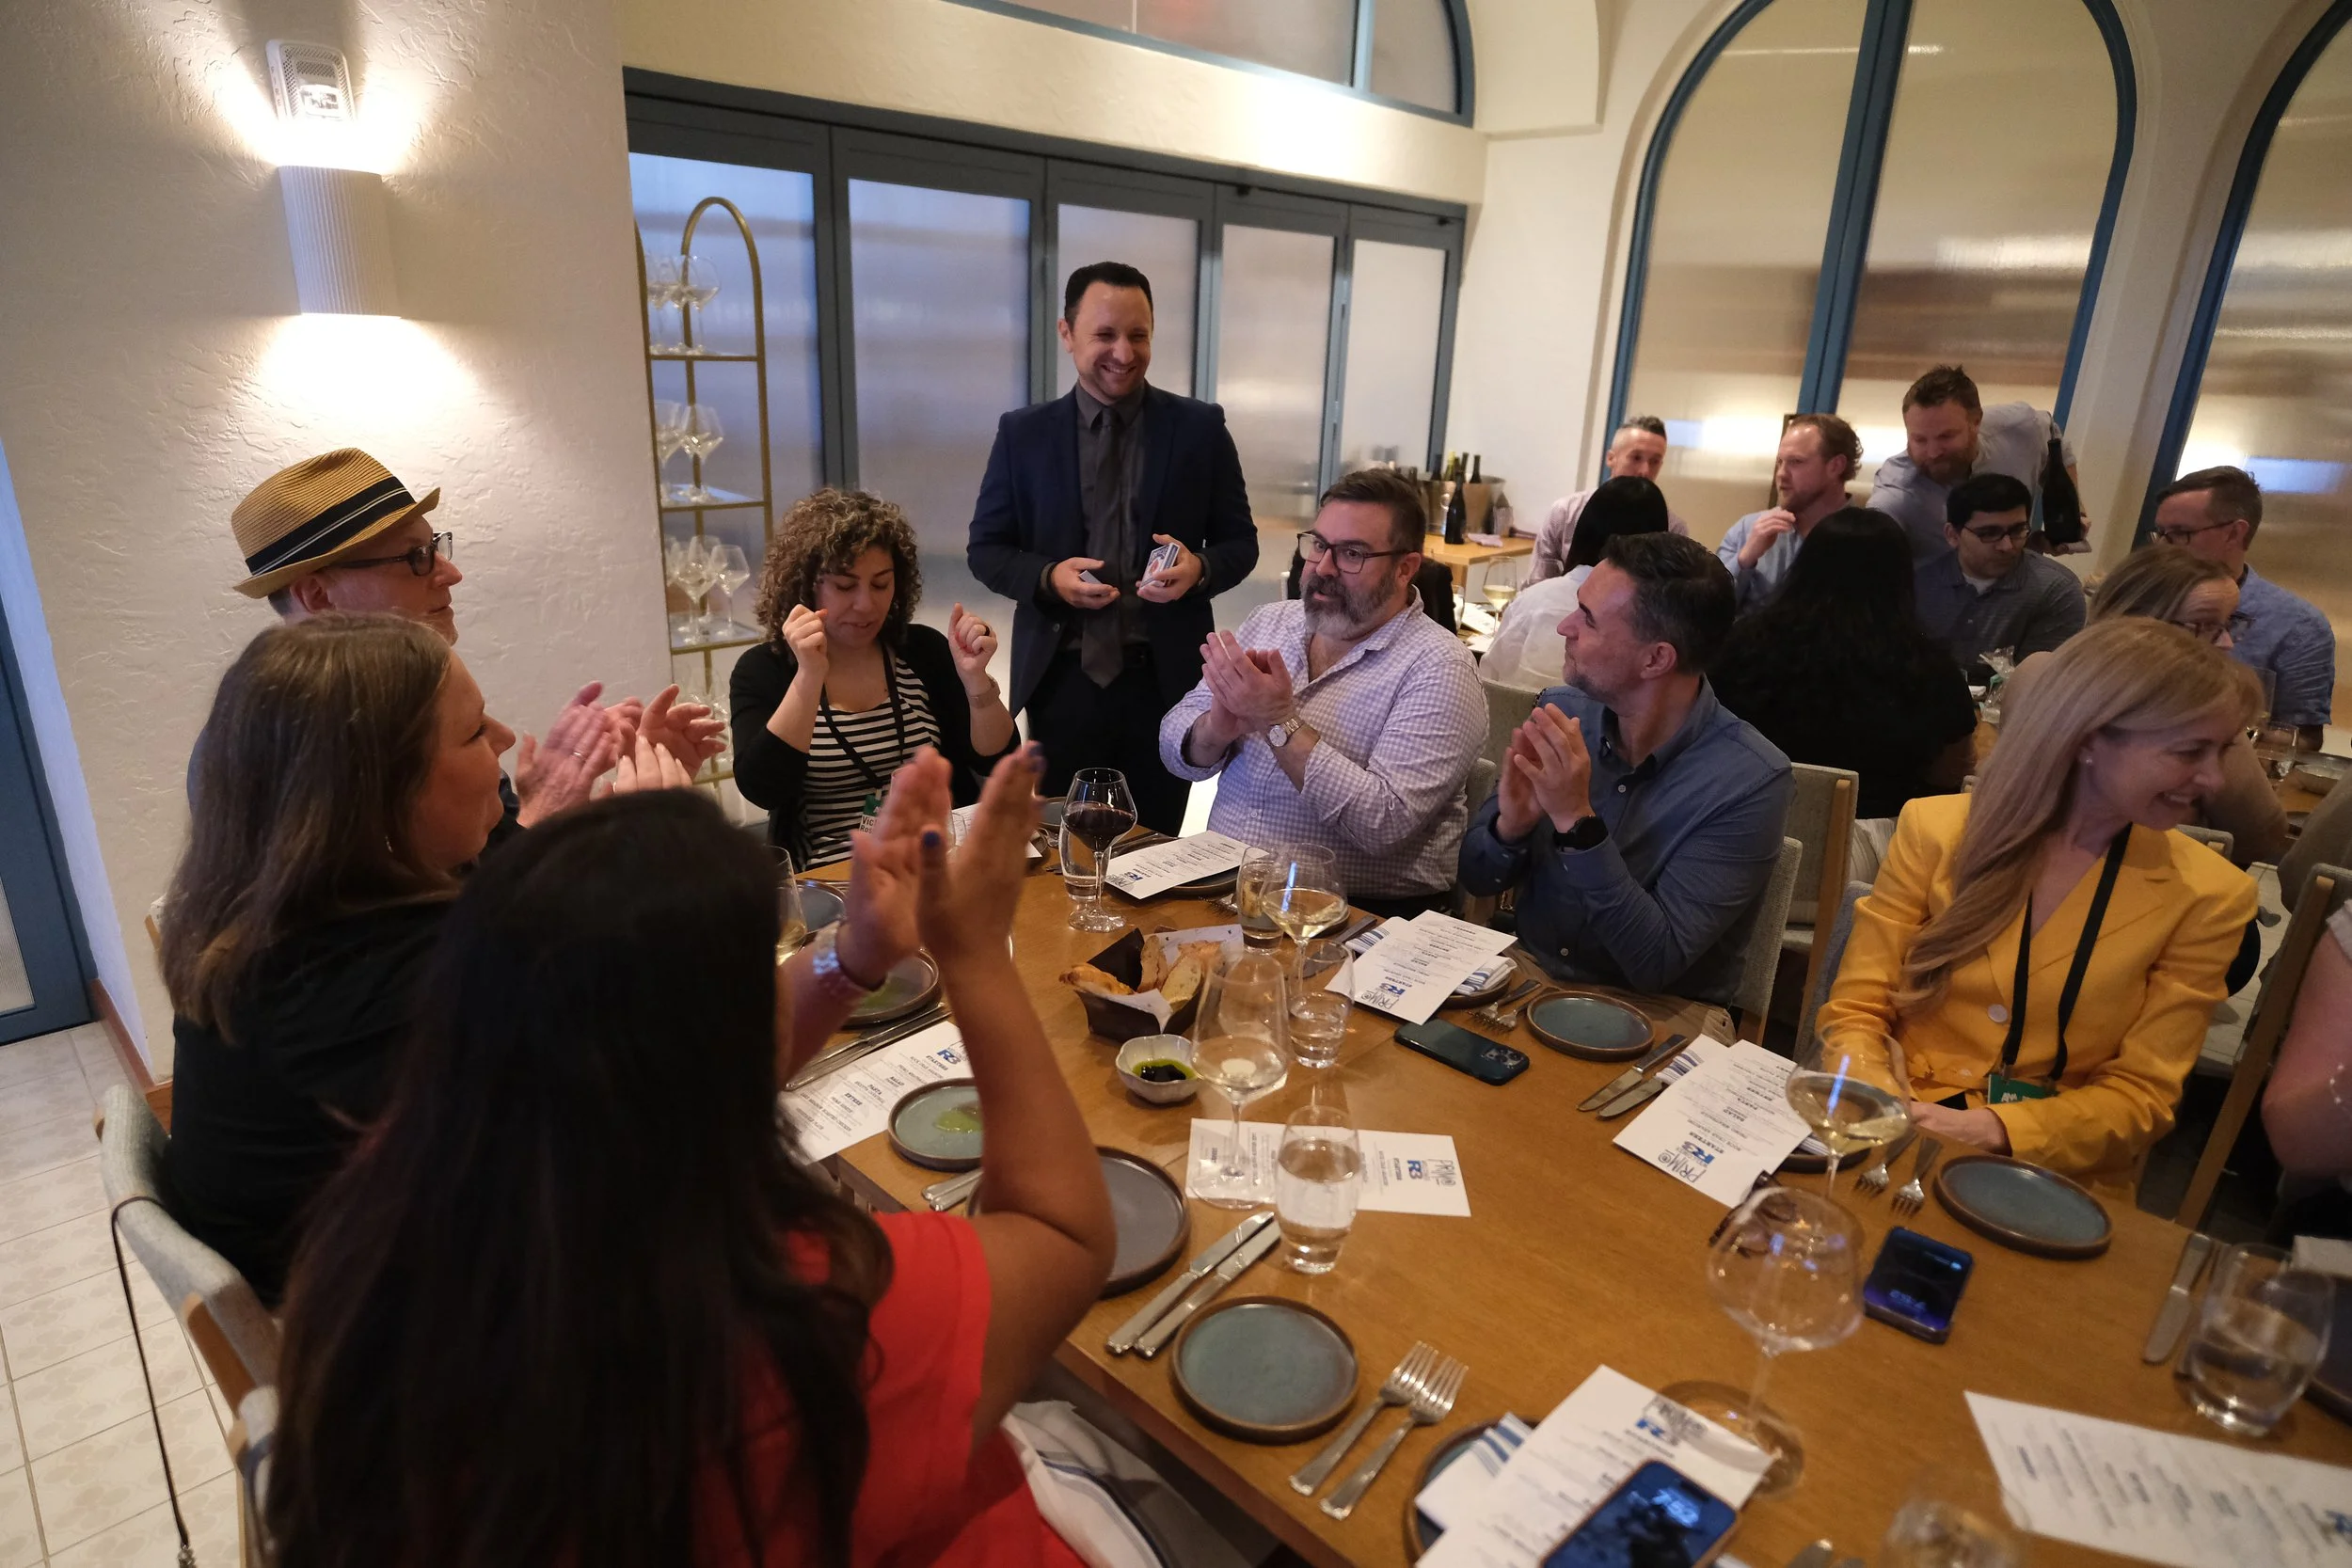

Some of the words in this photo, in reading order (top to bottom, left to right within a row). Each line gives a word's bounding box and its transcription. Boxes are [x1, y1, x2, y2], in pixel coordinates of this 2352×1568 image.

[862, 816, 877, 827] Vic
[937, 1049, 961, 1065] R3
[1681, 1141, 1715, 1165] R3
[1406, 1159, 1423, 1180] R3
[1658, 1148, 1708, 1183] PRIMO
